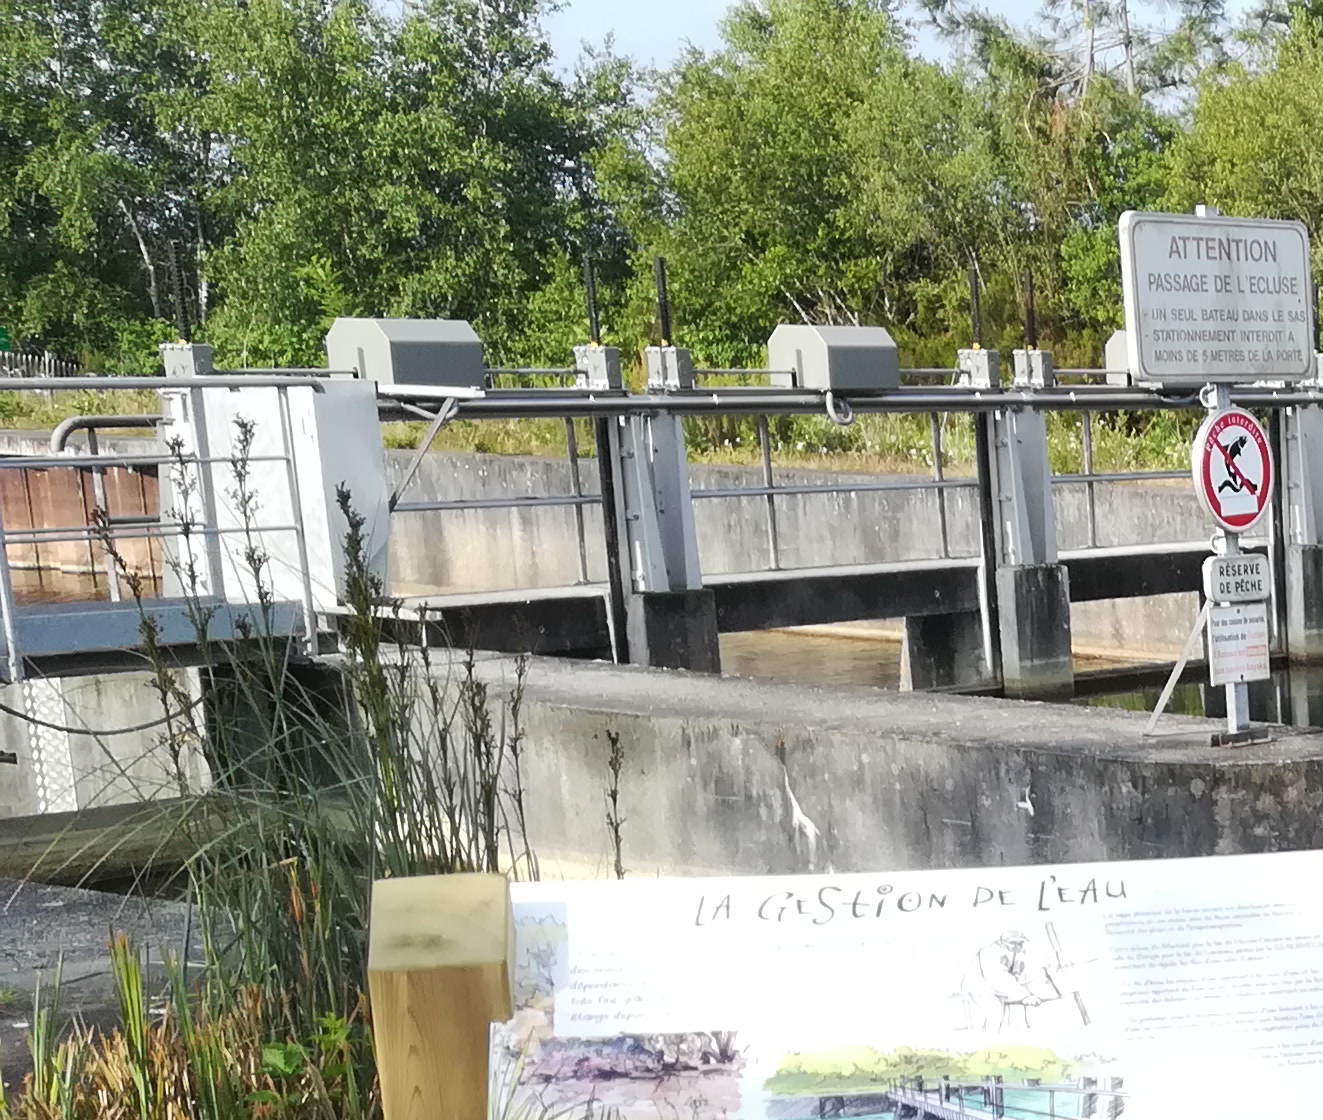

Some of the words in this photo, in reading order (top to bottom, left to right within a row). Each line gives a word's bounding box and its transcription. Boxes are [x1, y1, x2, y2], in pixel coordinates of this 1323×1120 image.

[1168, 235, 1277, 262] ATTENTION
[1148, 273, 1209, 293] PASSAGE
[1214, 275, 1231, 293] DE
[1237, 276, 1298, 295] L'ECLUSE
[1152, 308, 1166, 321] UN
[1171, 308, 1197, 321] SEUL
[1202, 309, 1239, 322] BATEAU
[1243, 309, 1268, 322] DANS
[1273, 310, 1284, 322] LE
[1288, 310, 1305, 322] SAS
[1153, 329, 1236, 342] STATIONNEMENT
[1240, 330, 1283, 342] INTERDIT
[1288, 331, 1295, 342] A
[1155, 350, 1183, 362] MOINS
[1187, 350, 1198, 362] DE
[1203, 350, 1208, 362] 5
[1211, 350, 1245, 362] METRES
[1247, 350, 1259, 362] DE
[1262, 350, 1273, 362] LA
[1277, 350, 1302, 363] PORTE
[1219, 563, 1260, 577] RÉSERVE
[1220, 582, 1231, 594] DE
[1235, 578, 1262, 592] PÊCHE
[695, 893, 731, 926] LA
[972, 885, 1016, 908] DE
[1038, 874, 1128, 911] L'EAU
